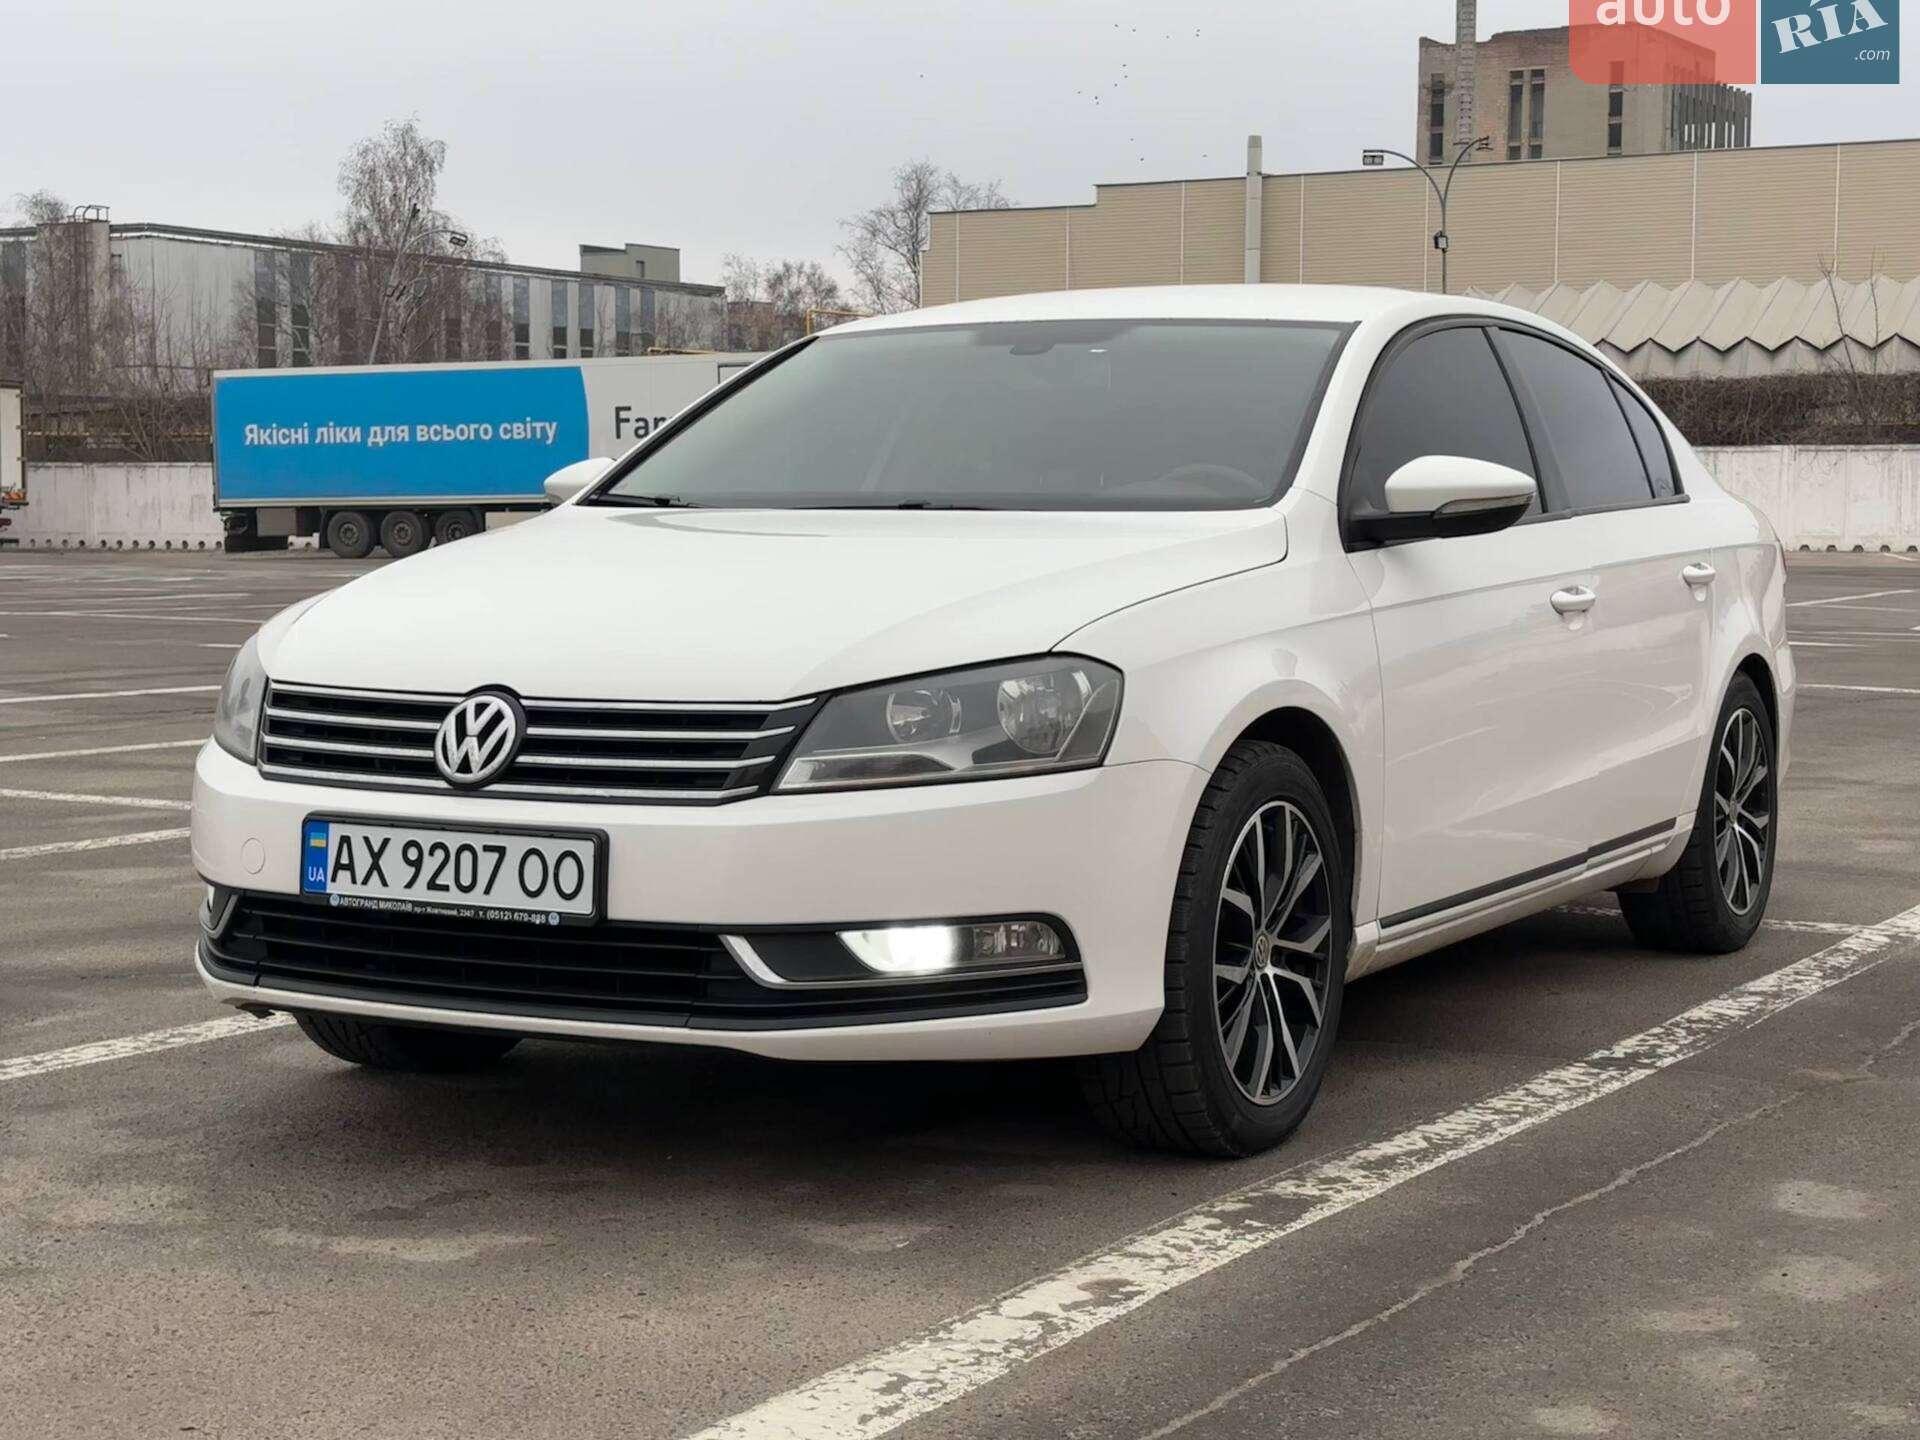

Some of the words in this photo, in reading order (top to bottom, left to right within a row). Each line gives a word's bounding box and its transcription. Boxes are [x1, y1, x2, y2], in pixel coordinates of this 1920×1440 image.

[244, 422, 309, 446] Якісні
[315, 421, 362, 443] ліки
[367, 424, 409, 447] для
[416, 419, 493, 441] всього
[499, 417, 558, 444] світу
[308, 866, 325, 882] UA
[330, 834, 391, 888] AX
[402, 838, 507, 895] 9207
